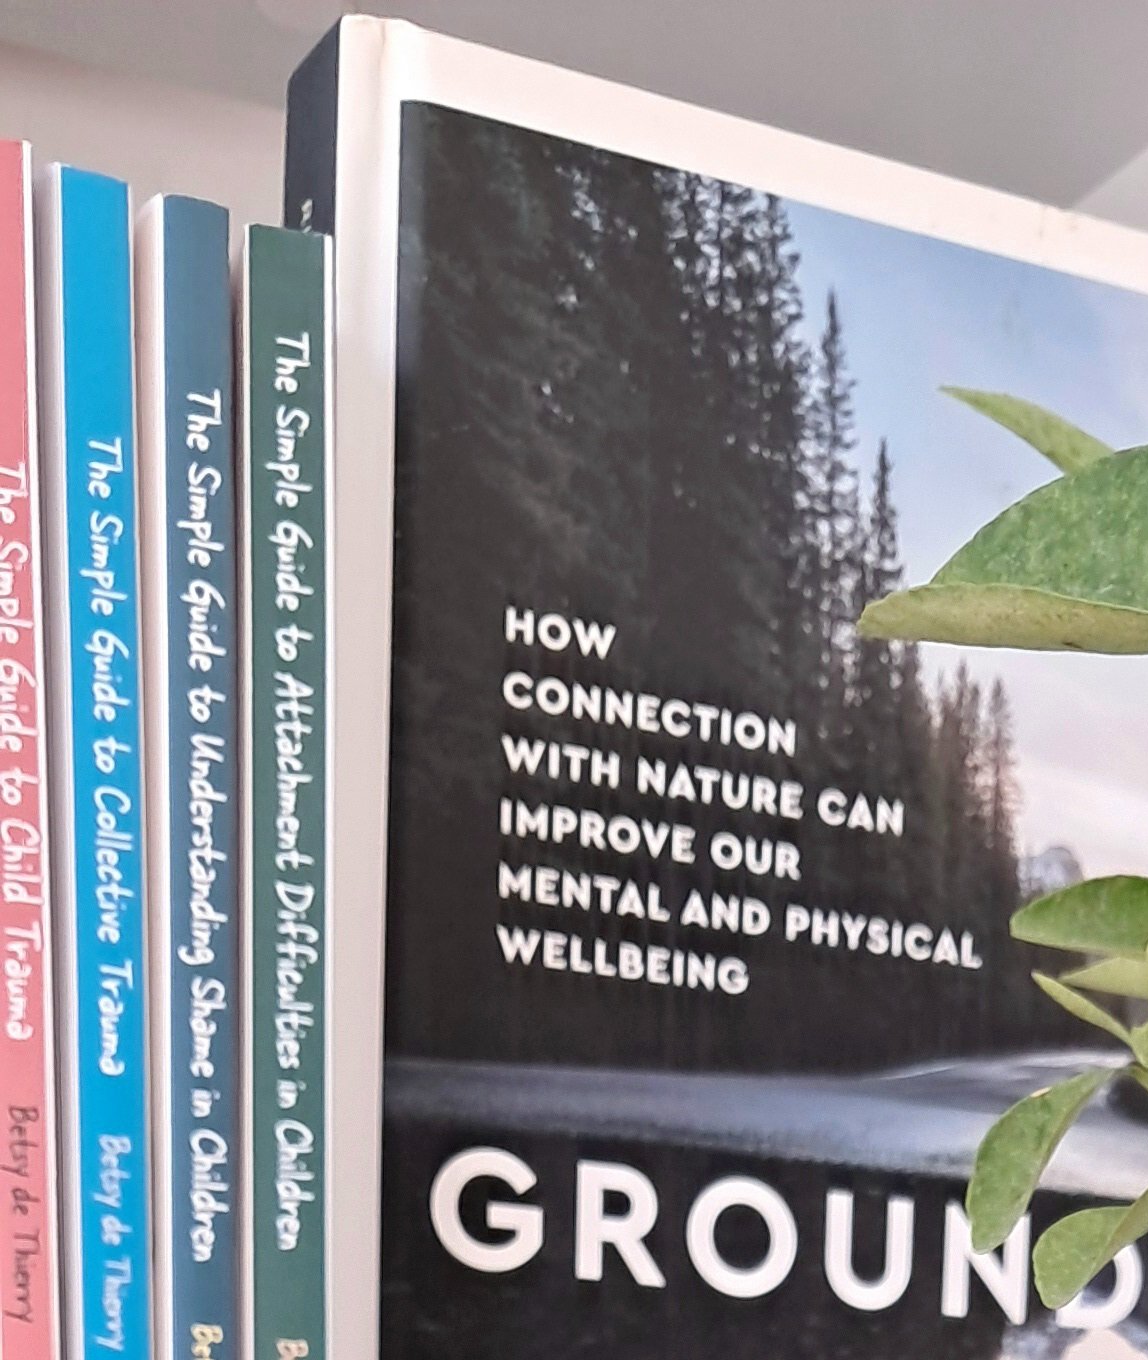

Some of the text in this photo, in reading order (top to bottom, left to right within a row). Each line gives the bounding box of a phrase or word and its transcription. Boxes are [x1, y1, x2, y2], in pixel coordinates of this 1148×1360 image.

[504, 606, 616, 660] HOW
[0, 659, 37, 752] Guide
[80, 437, 134, 1075] The Simple Guide to Collective Trauma
[502, 671, 796, 757] CONNECTION
[0, 764, 40, 805] to
[177, 388, 229, 1262] The Simple Guide to Understanding Shame in Children
[266, 332, 318, 1251] The Simple Guide to Attachment Difficulties in Children
[502, 735, 904, 836] WITH NATURE CAN
[2, 820, 43, 906] Child
[500, 798, 800, 881] IMPROVE OUR
[496, 925, 748, 995] WELLBEING
[498, 862, 983, 970] MENTAL AND PHYSICAL
[6, 924, 40, 1039] Trauma
[2, 1107, 41, 1323] Betsy de Thierry
[94, 1135, 130, 1350] Betsy de Thierry
